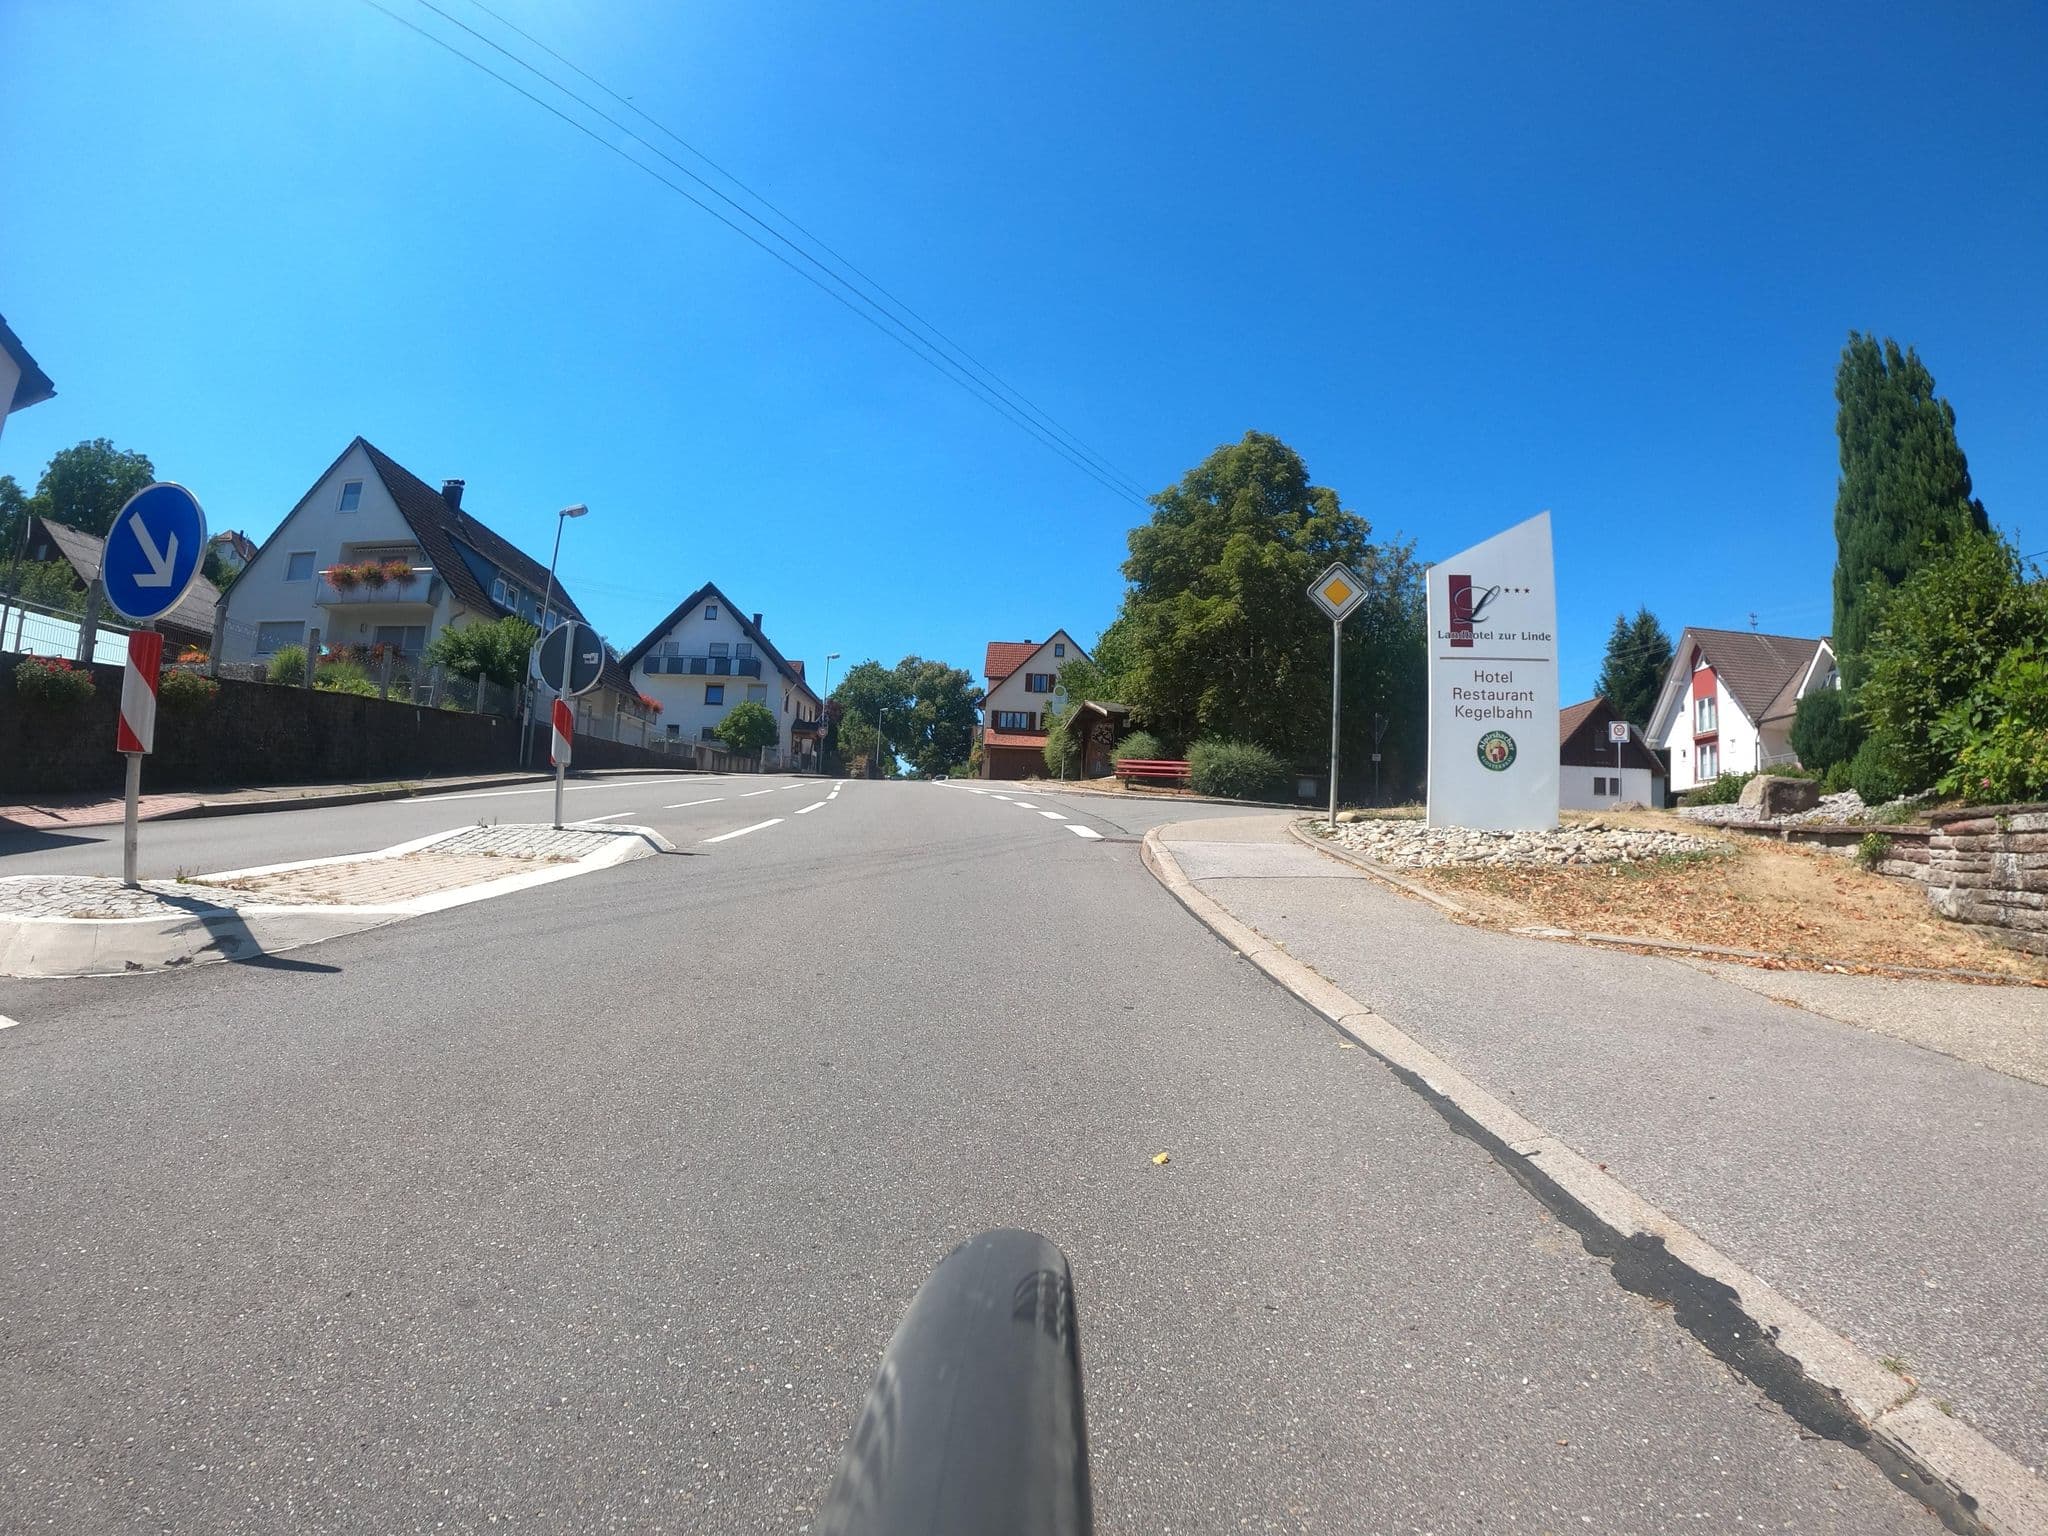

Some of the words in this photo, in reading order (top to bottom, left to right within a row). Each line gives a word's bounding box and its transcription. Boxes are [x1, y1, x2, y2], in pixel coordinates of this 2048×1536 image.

[1438, 630, 1493, 640] Landhotel
[1499, 632, 1517, 640] zur
[1521, 631, 1551, 641] Linde
[1474, 670, 1513, 683] Hotel
[1453, 687, 1534, 701] Restaurant
[1455, 705, 1533, 721] Kegelbahn
